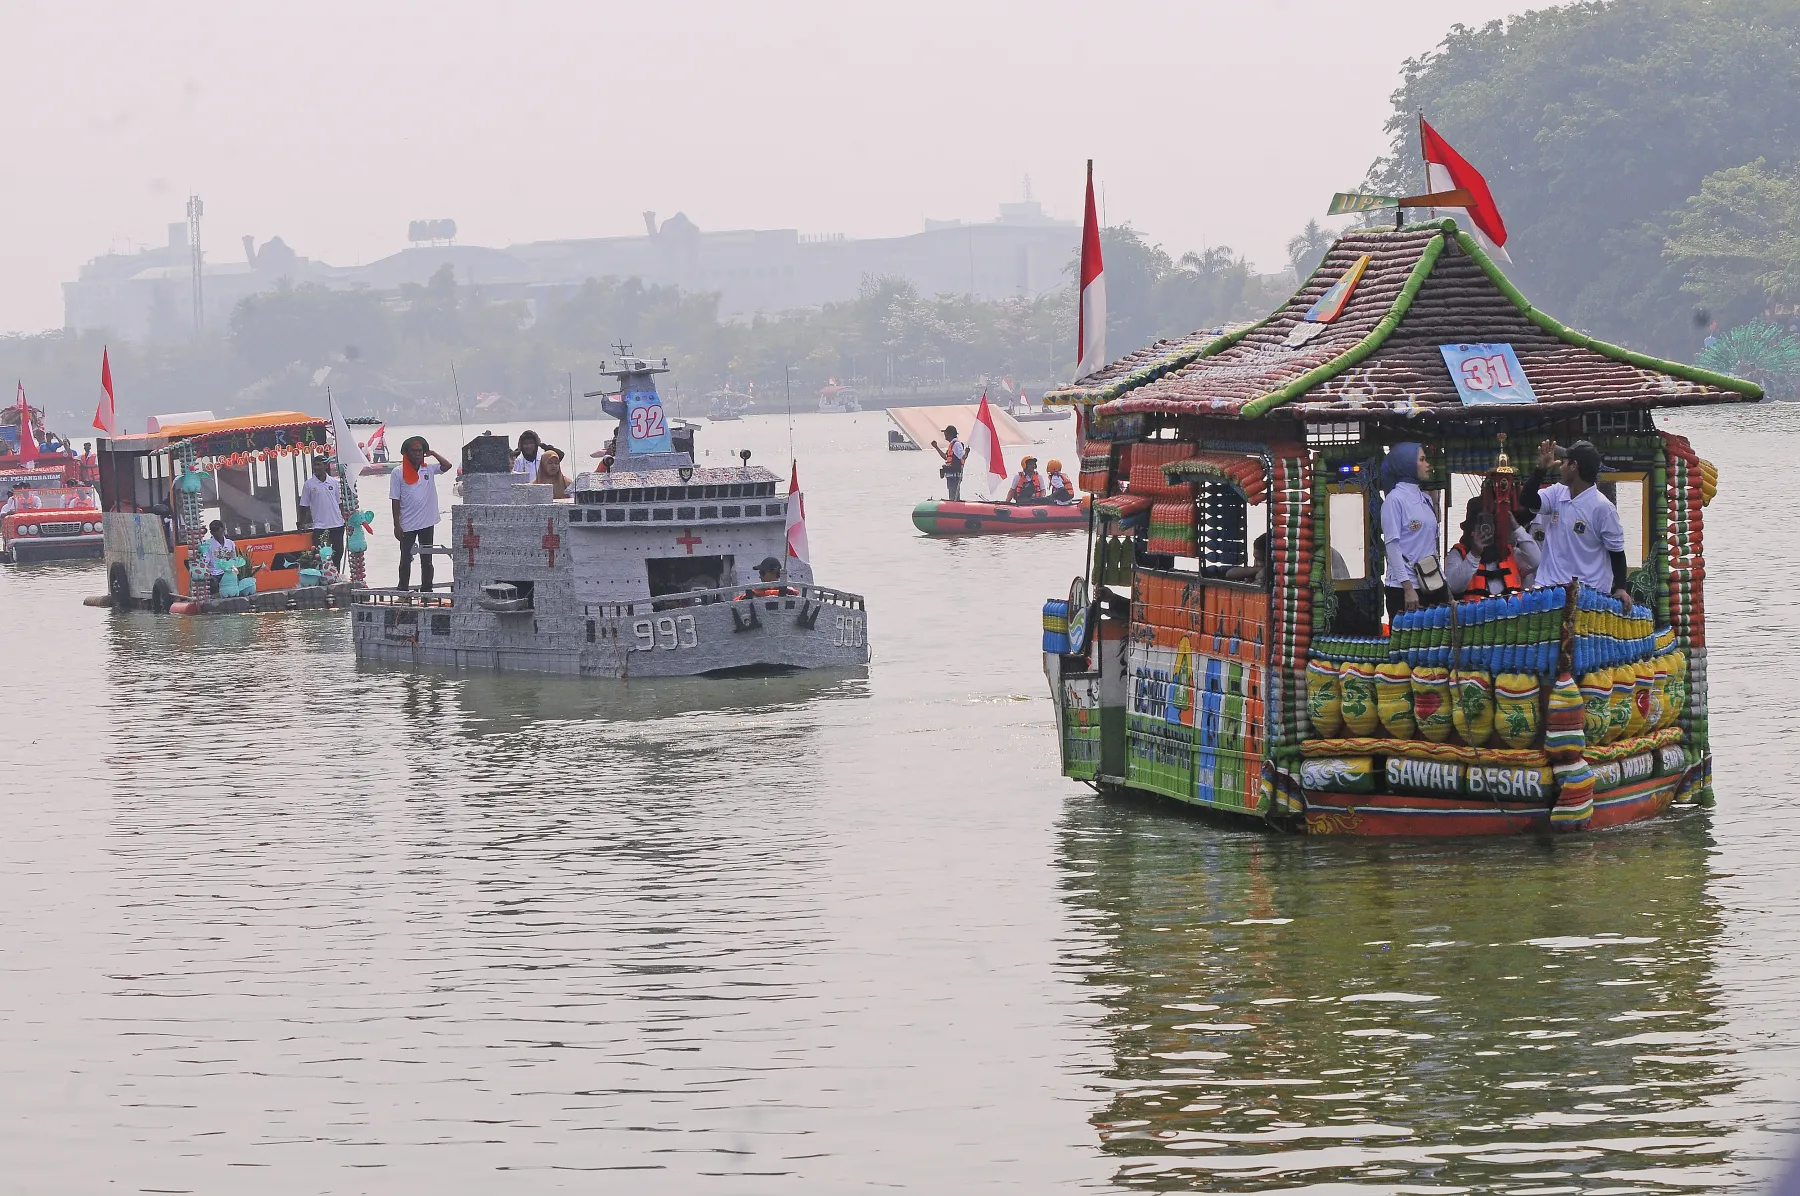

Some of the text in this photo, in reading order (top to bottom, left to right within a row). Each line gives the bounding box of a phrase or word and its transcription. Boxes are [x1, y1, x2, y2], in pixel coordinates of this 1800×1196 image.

[1461, 353, 1513, 391] 31
[631, 404, 665, 440] 32
[632, 614, 699, 651] 993
[833, 614, 864, 648] 993
[1387, 758, 1543, 798] SAWAH BESAR
